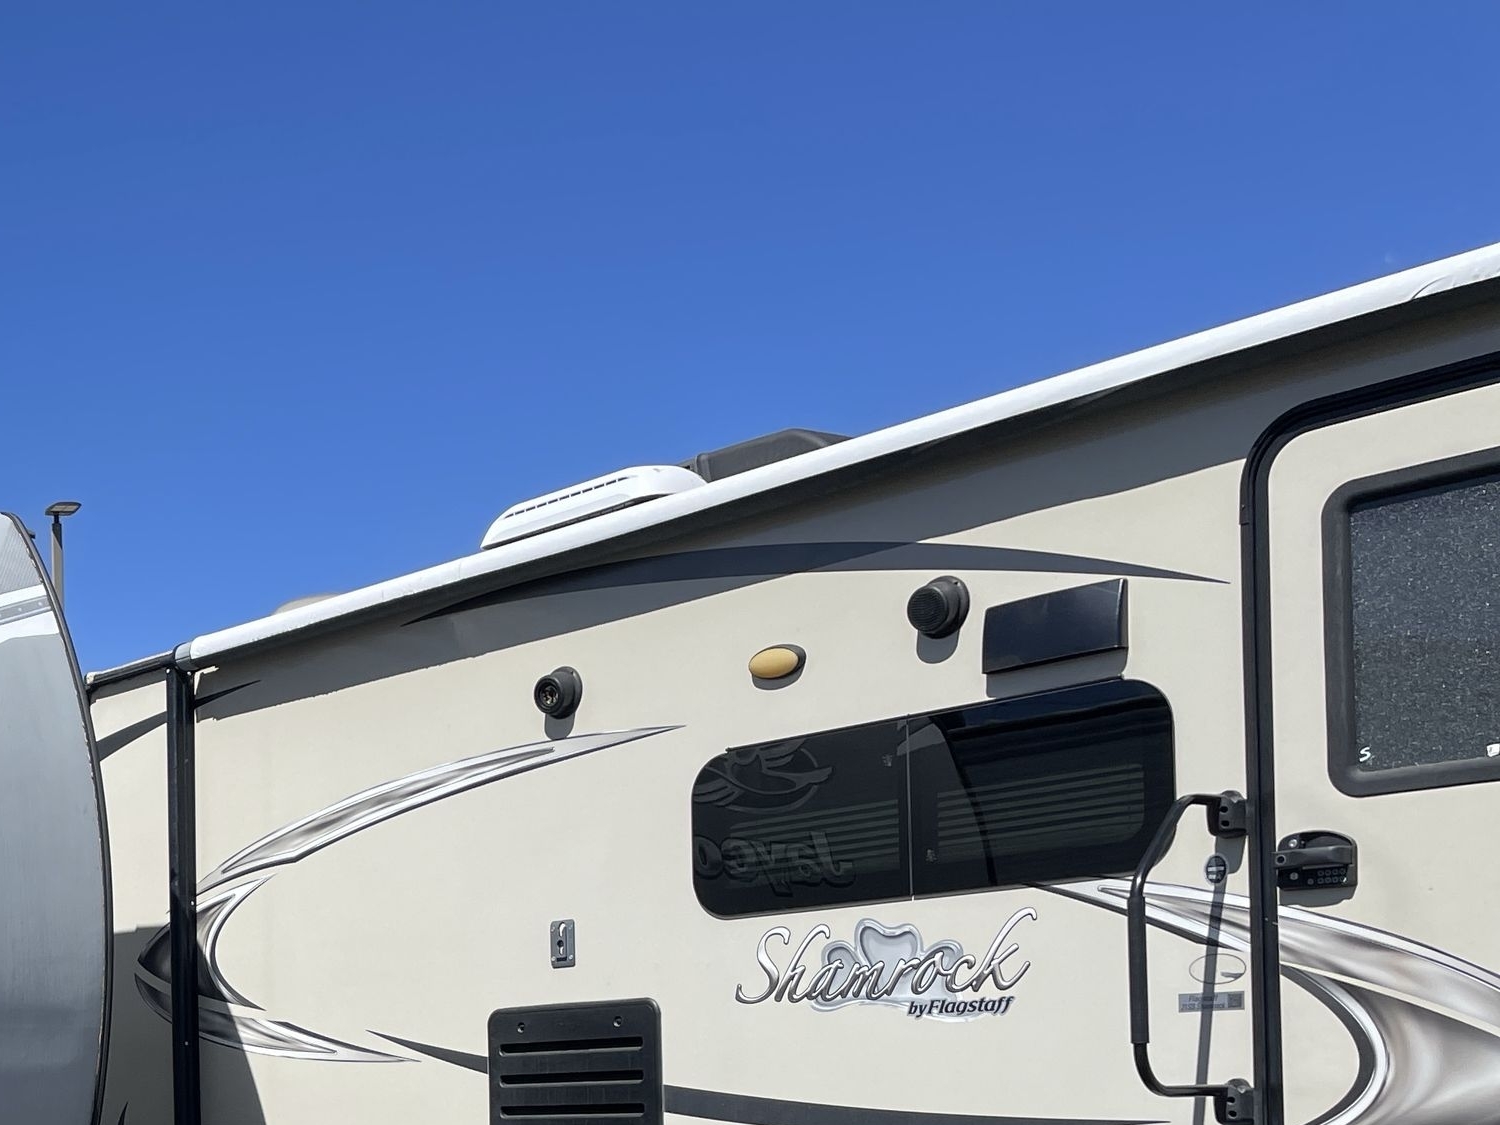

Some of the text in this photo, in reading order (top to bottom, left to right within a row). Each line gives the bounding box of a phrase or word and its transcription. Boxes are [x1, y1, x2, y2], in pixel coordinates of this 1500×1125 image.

[734, 906, 1038, 1005] Shamrock
[908, 996, 1016, 1018] by Flagstaff
